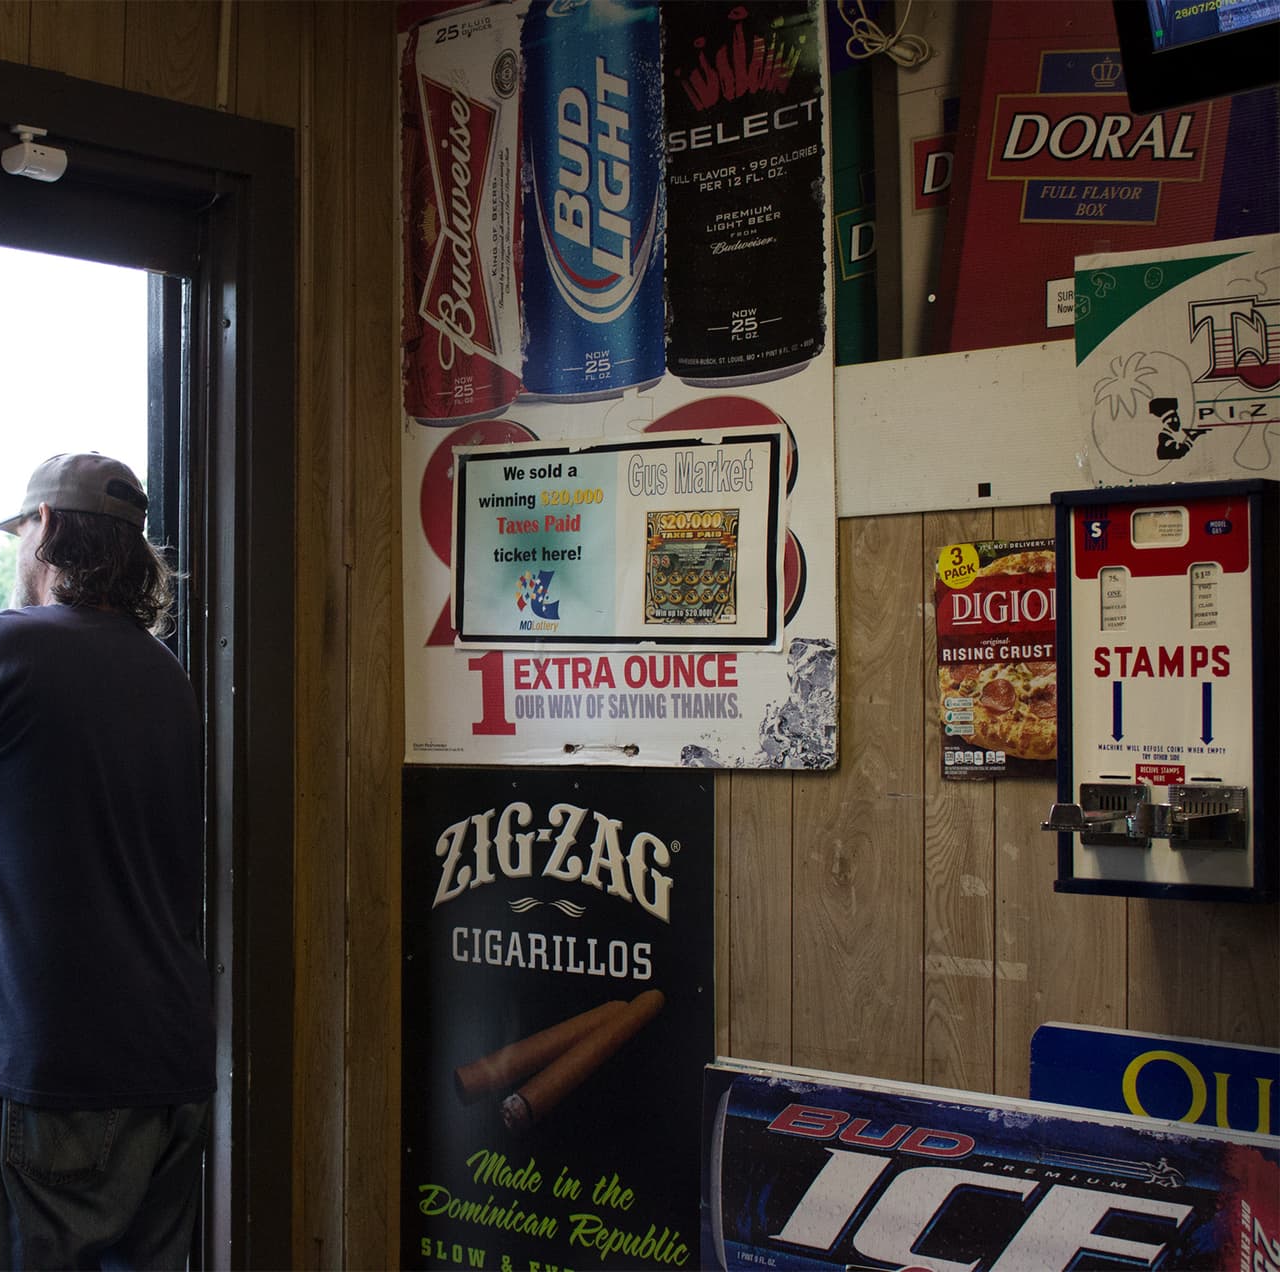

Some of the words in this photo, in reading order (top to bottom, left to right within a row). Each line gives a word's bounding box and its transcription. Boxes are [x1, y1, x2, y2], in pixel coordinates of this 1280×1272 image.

[435, 23, 459, 44] 25
[461, 17, 491, 30] FLUID
[461, 23, 492, 36] OUNCES
[668, 97, 818, 153] SELECT
[1001, 111, 1199, 162] DORAL
[554, 87, 591, 249] BUD
[592, 55, 633, 279] LIGHT
[670, 171, 690, 187] FULL
[692, 164, 737, 183] FLAVOR
[749, 158, 768, 172] 99
[769, 144, 819, 169] CALORIES
[699, 179, 725, 193] PER
[727, 175, 743, 189] 12
[745, 172, 765, 185] FL.
[766, 167, 788, 181] OZ.
[1040, 184, 1079, 201] FULL
[1081, 185, 1143, 202] FLAVOR
[715, 204, 773, 223] PREMIUM
[1075, 202, 1108, 218] BOX
[706, 219, 744, 232] LIGHT
[747, 210, 782, 226] BEER
[730, 228, 757, 239] FROM
[731, 307, 758, 319] NOW
[731, 317, 759, 334] 25
[585, 350, 610, 361] NOW
[585, 359, 611, 373] 25
[454, 375, 474, 386] NOW
[454, 383, 474, 398] 25
[503, 465, 526, 481] We
[529, 464, 563, 480] sold
[567, 466, 577, 478] a
[627, 453, 669, 497] Gus
[673, 447, 754, 495] Market
[478, 493, 536, 509] winning
[541, 488, 604, 508] $20,000
[496, 516, 540, 535] Taxes
[544, 513, 581, 533] Paid
[661, 531, 694, 539] TAXES
[696, 530, 722, 538] PAID
[1091, 521, 1102, 538] S
[493, 546, 537, 564] ticket
[542, 545, 582, 562] here!
[950, 547, 964, 567] 3
[944, 562, 977, 581] PACK
[655, 608, 667, 618] Win
[942, 647, 994, 662] RISING
[999, 643, 1054, 659] CRUST
[1094, 645, 1231, 678] STAMPS
[513, 655, 616, 691] EXTRA
[624, 653, 738, 689] OUNCE
[468, 651, 517, 736] 1
[514, 693, 545, 719] OUR
[548, 693, 584, 719] WAY
[586, 693, 605, 719] OF
[608, 693, 668, 719] SAYING
[671, 692, 743, 720] THANKS.
[1098, 743, 1123, 751] MACHINE
[1126, 744, 1140, 752] WILL
[1207, 747, 1227, 755] EMPTY
[1153, 753, 1168, 761] OTHER
[1161, 766, 1180, 774] STAMPS
[432, 800, 675, 925] ZIG-ZAG
[451, 926, 654, 981] CIGARILLOS
[767, 1102, 977, 1161] BUD
[465, 1148, 544, 1194] Made
[552, 1166, 582, 1201] in
[591, 1174, 636, 1211] the
[982, 1160, 1130, 1190] PREMIUM
[768, 1145, 1195, 1272] ICE
[1240, 1199, 1251, 1233] ONE
[416, 1183, 560, 1241] Dominican
[568, 1212, 691, 1267] Republic
[420, 1237, 486, 1269] SLOW
